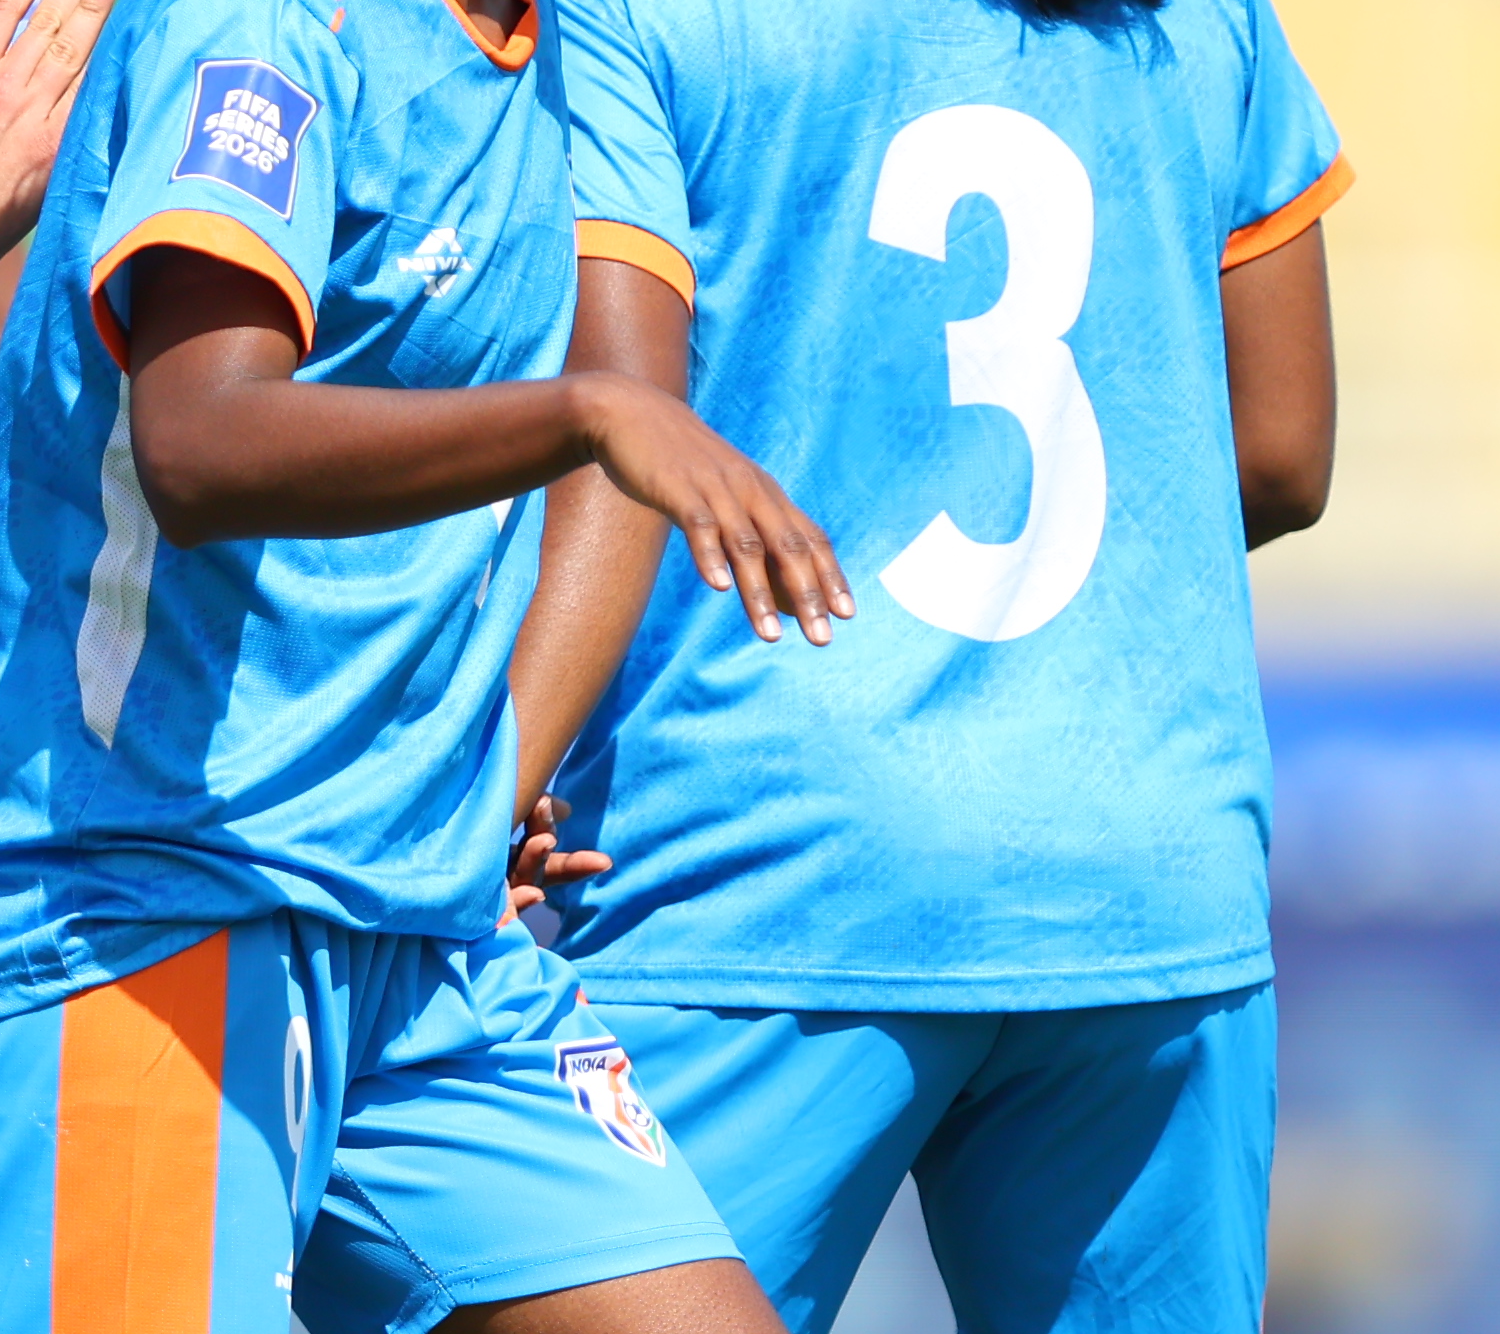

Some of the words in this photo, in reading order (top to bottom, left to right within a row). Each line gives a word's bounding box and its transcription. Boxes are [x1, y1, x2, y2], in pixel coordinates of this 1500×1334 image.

[223, 88, 281, 130] FIFA
[202, 109, 290, 161] SERIES
[207, 129, 274, 175] 2026
[868, 104, 1107, 643] 3
